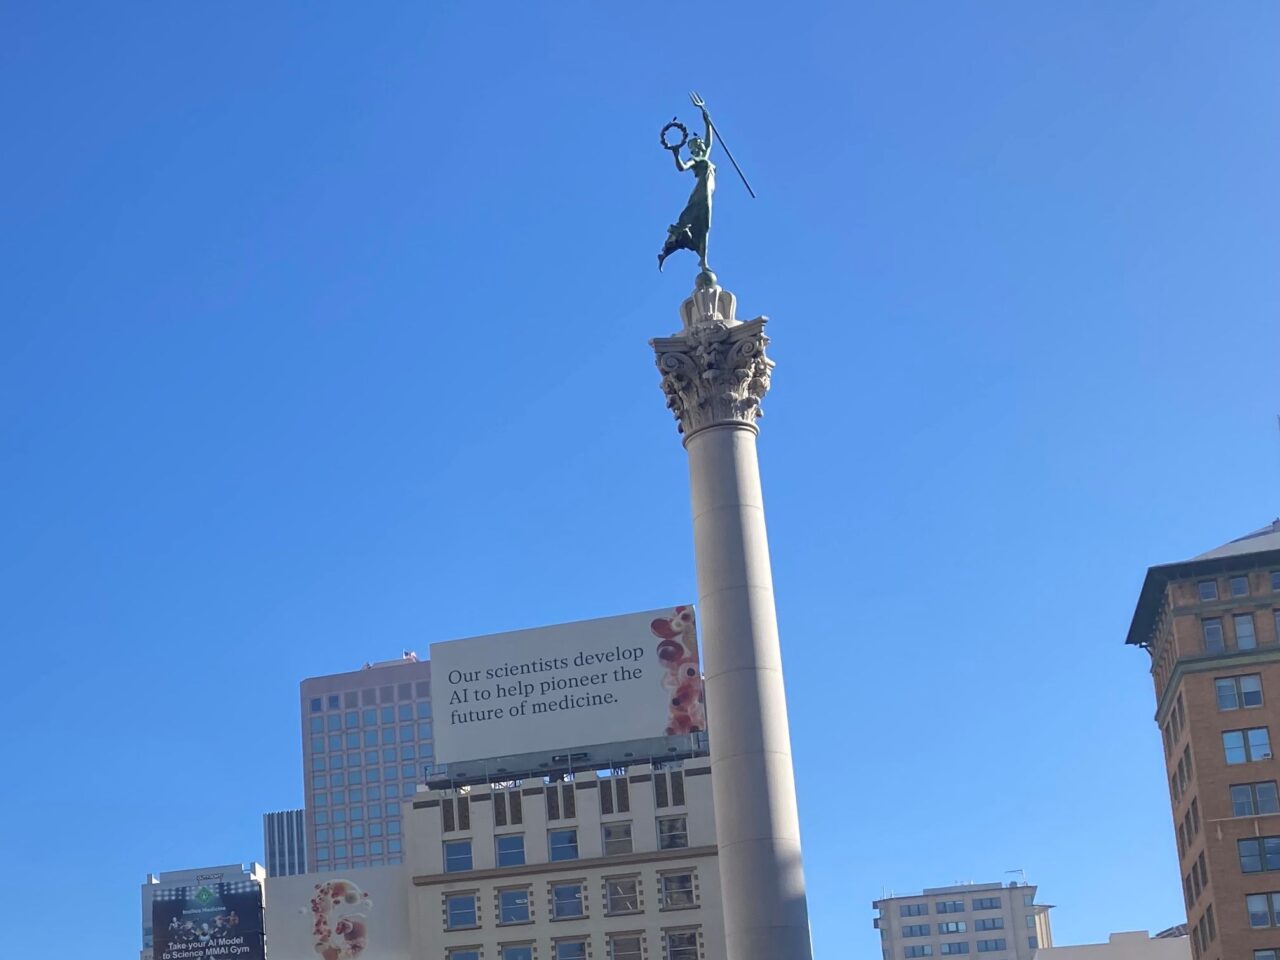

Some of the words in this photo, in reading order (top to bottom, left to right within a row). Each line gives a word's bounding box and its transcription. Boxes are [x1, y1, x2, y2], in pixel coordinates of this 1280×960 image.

[448, 669, 482, 685] Our
[485, 657, 569, 680] scientists
[573, 646, 644, 668] develop
[449, 689, 469, 705] AI
[473, 687, 491, 702] to
[496, 681, 535, 699] help
[540, 673, 608, 696] pioneer
[613, 665, 643, 682] the
[450, 706, 504, 725] future
[509, 700, 528, 717] of
[532, 691, 619, 715] medicine.
[162, 952, 170, 960] to
[172, 948, 204, 959] Science
[205, 947, 229, 956] MMAI
[230, 944, 250, 955] Gym
[168, 941, 187, 951] Take
[188, 941, 206, 950] your
[208, 938, 217, 947] AI
[218, 936, 244, 945] Model
